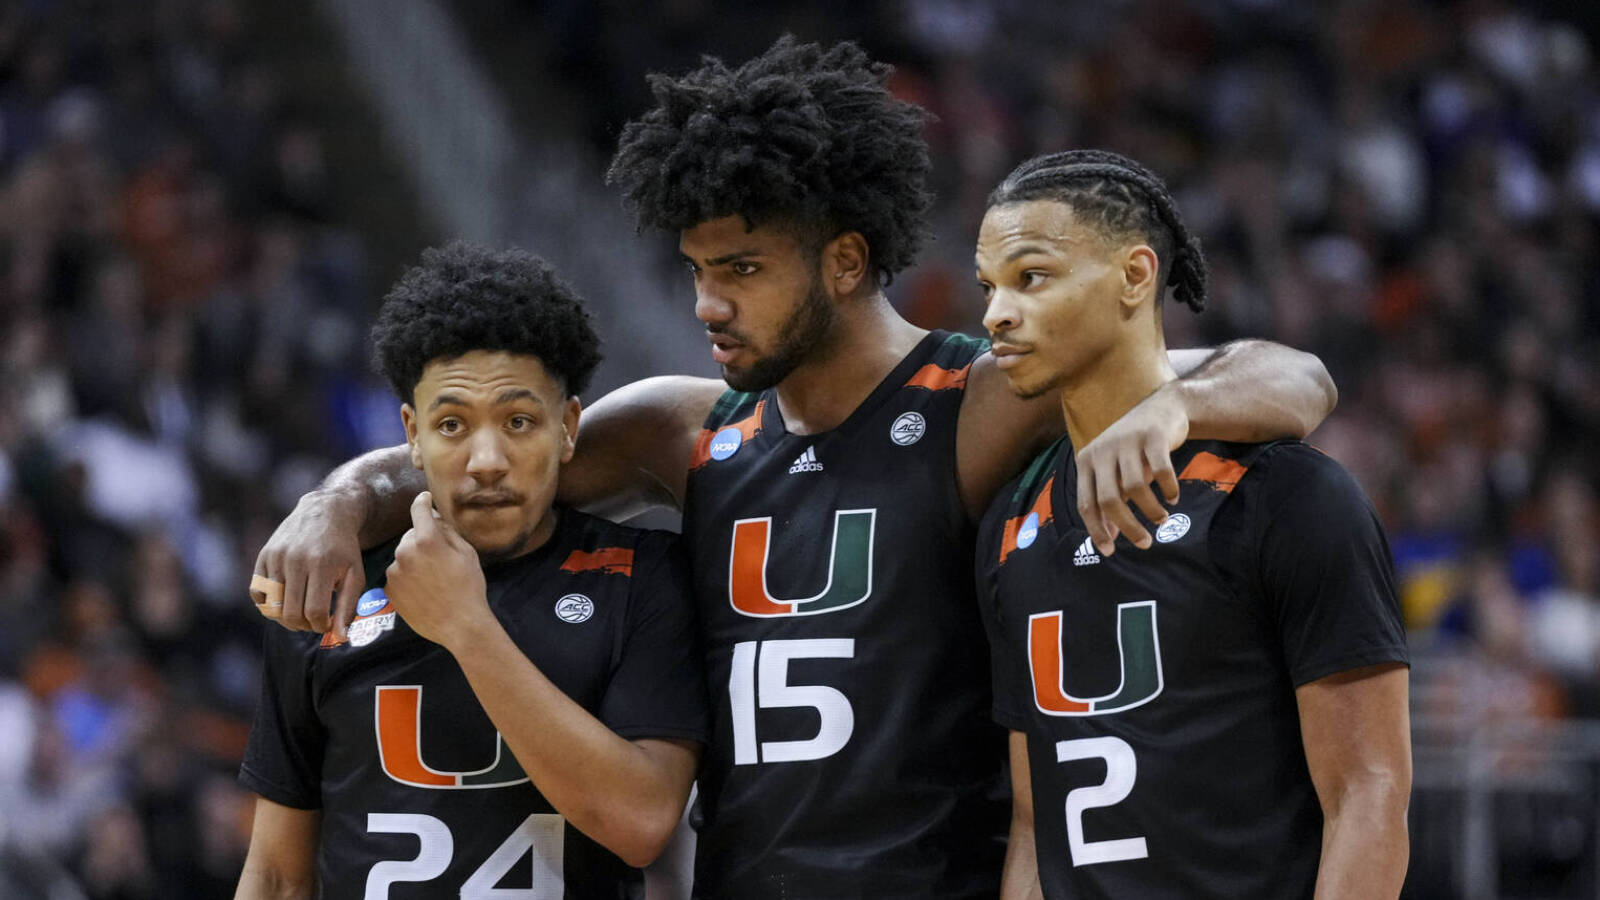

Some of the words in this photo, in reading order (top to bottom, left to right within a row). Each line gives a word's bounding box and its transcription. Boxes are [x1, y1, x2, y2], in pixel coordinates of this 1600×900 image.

[789, 462, 824, 475] adidas
[898, 423, 923, 432] ACC
[560, 603, 590, 612] ACC
[729, 508, 877, 618] U
[1073, 554, 1101, 567] adidas
[729, 638, 855, 766] 15
[1028, 600, 1164, 717] U
[374, 684, 531, 790] U
[1055, 735, 1149, 867] 2
[364, 812, 566, 900] 24
